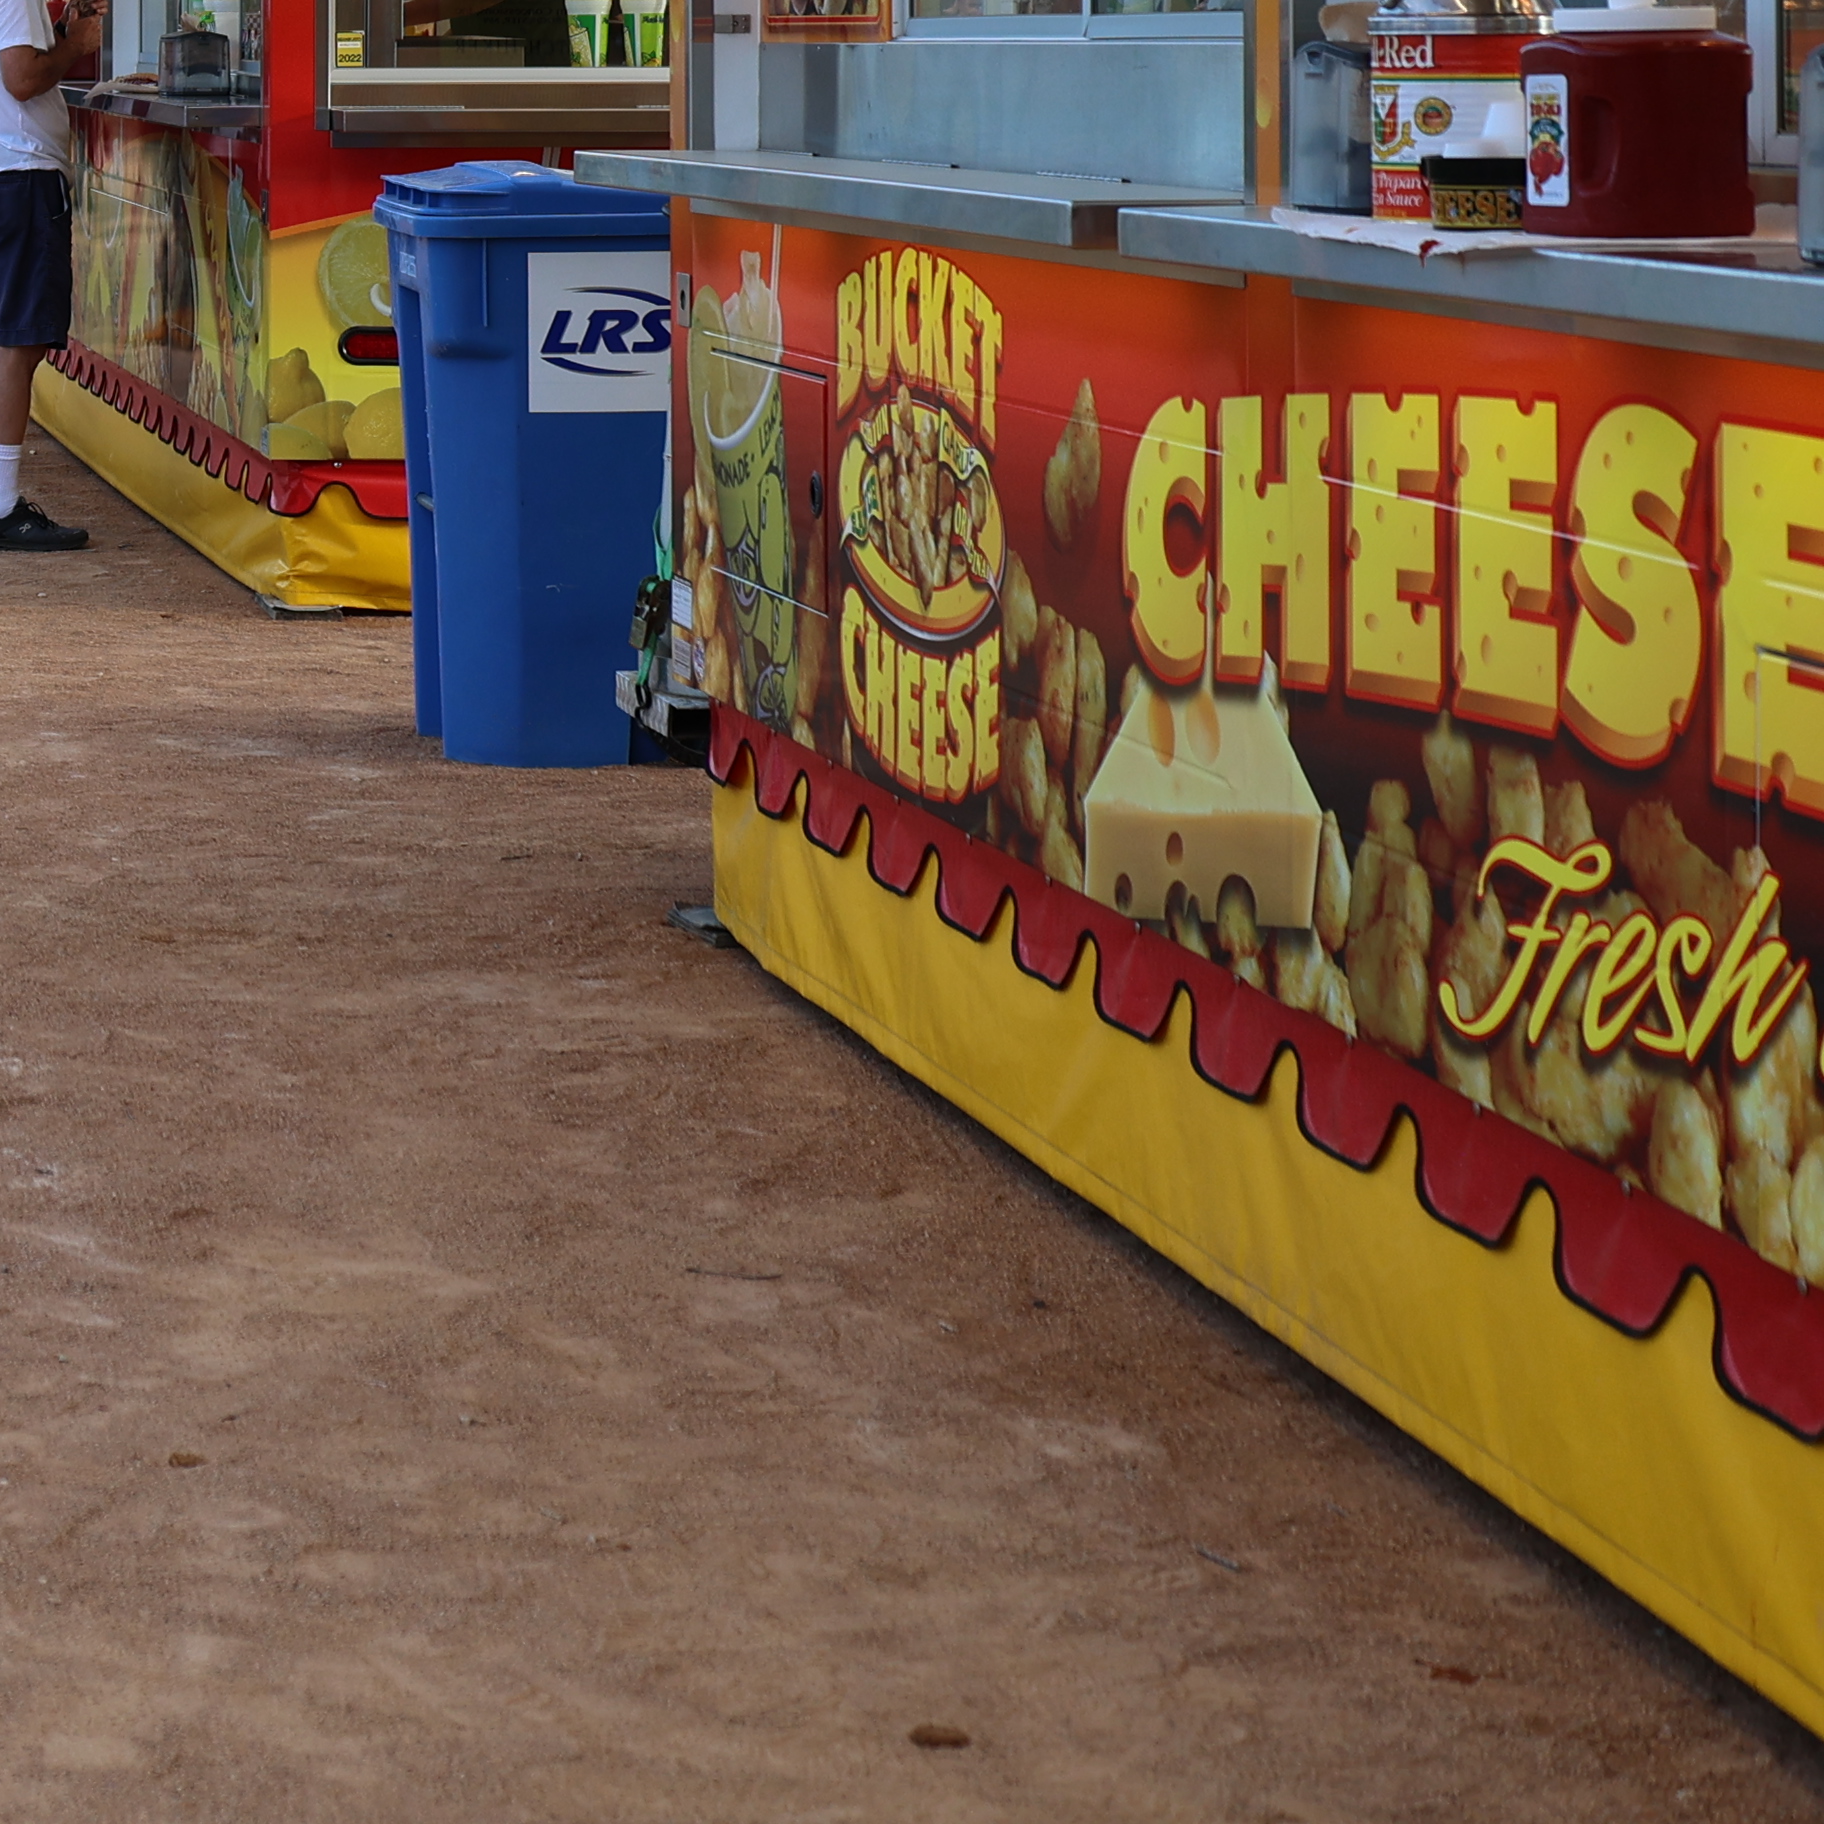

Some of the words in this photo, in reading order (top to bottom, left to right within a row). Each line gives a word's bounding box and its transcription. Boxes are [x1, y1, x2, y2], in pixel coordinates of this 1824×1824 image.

[338, 53, 362, 63] 2022
[1385, 190, 1424, 207] Sauce
[540, 309, 672, 354] LRS
[836, 246, 1002, 441] BUCKET
[842, 587, 1002, 803] CHEESE
[1124, 393, 1824, 821] CHEESE
[1440, 835, 1809, 1067] Fresh
